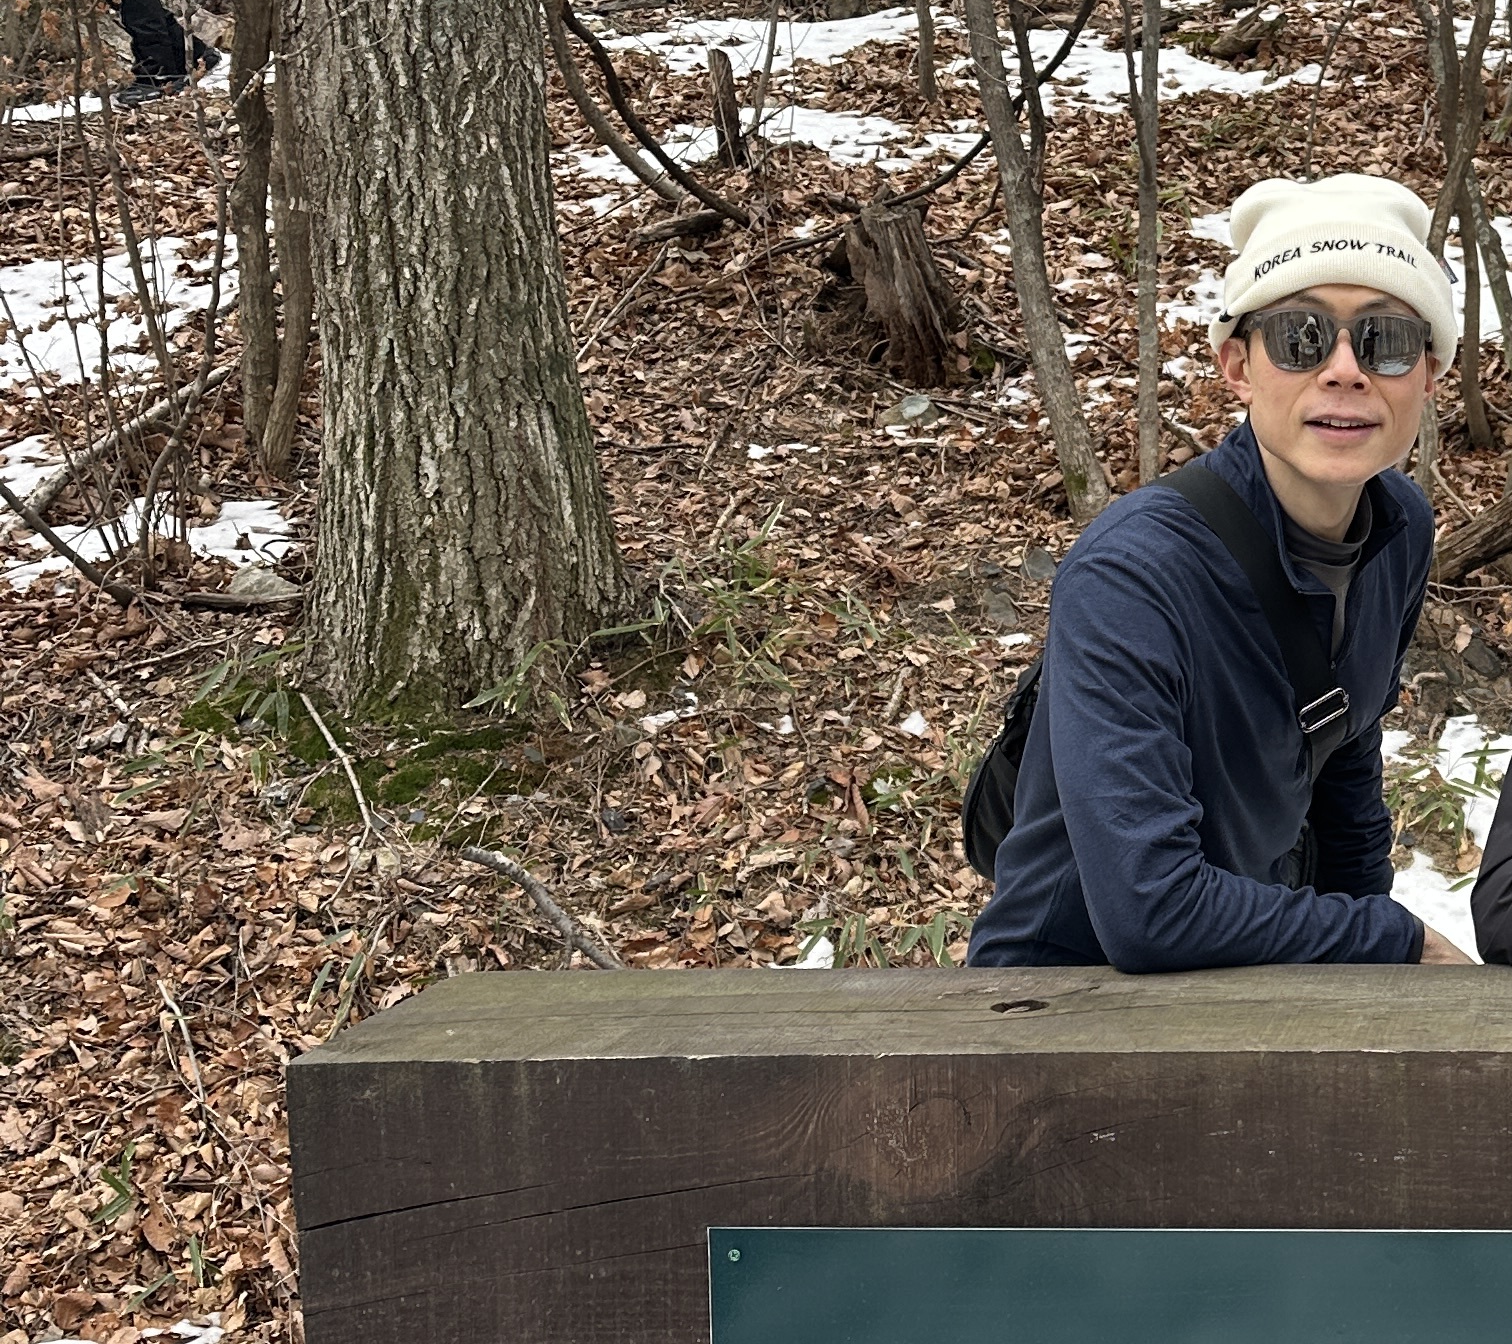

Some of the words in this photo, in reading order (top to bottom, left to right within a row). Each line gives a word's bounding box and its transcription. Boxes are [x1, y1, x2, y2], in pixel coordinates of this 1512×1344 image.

[1254, 246, 1301, 281] KOREA
[1310, 239, 1371, 254] SNOW
[1376, 243, 1418, 269] TRAIL
